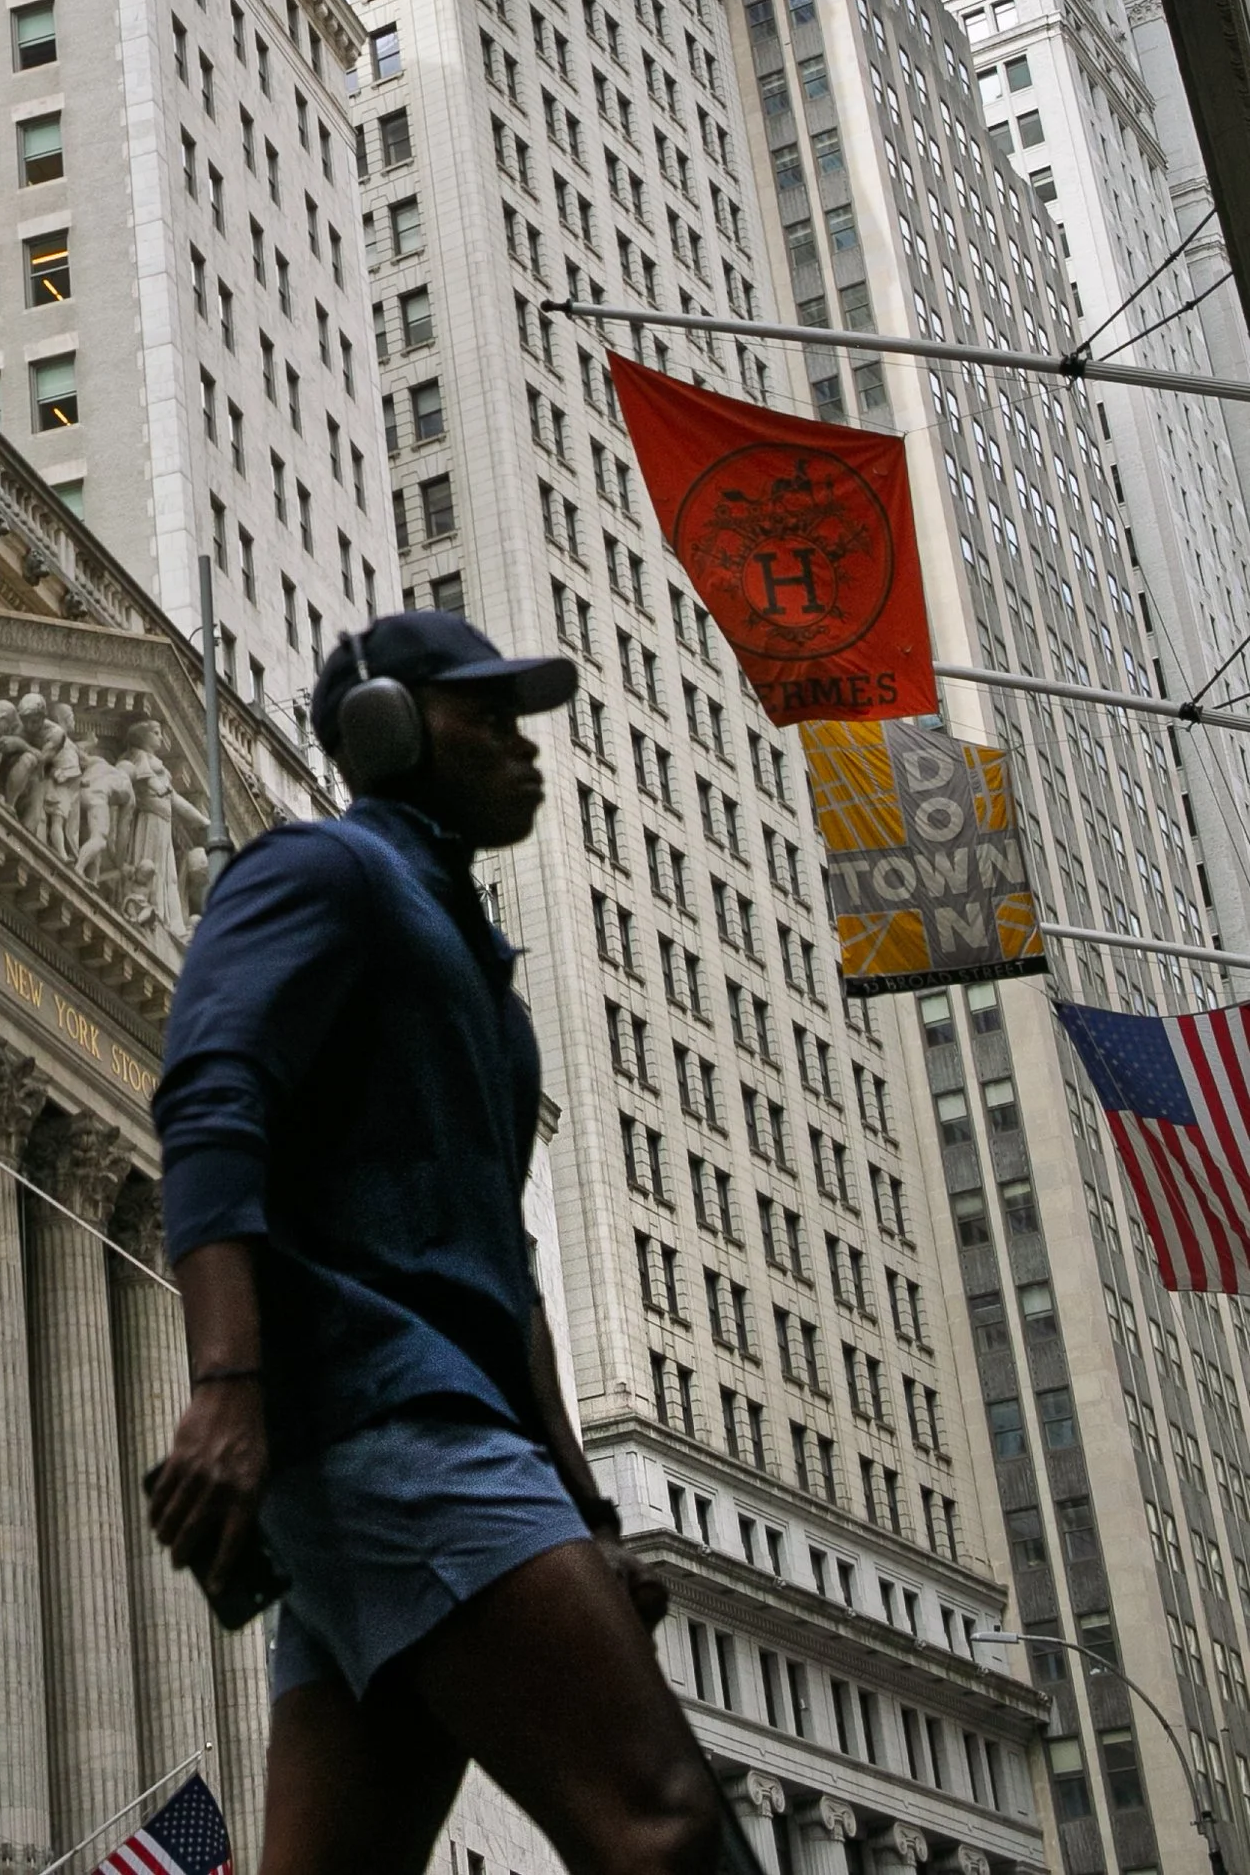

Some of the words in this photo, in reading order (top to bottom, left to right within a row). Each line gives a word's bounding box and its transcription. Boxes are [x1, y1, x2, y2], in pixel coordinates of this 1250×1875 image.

[753, 547, 826, 615] H
[752, 672, 898, 713] ERMES
[829, 839, 1026, 906] TOWN
[5, 952, 43, 1008] NEW
[54, 994, 101, 1061] YORK
[884, 971, 952, 992] BROAD
[959, 960, 1025, 982] STREET
